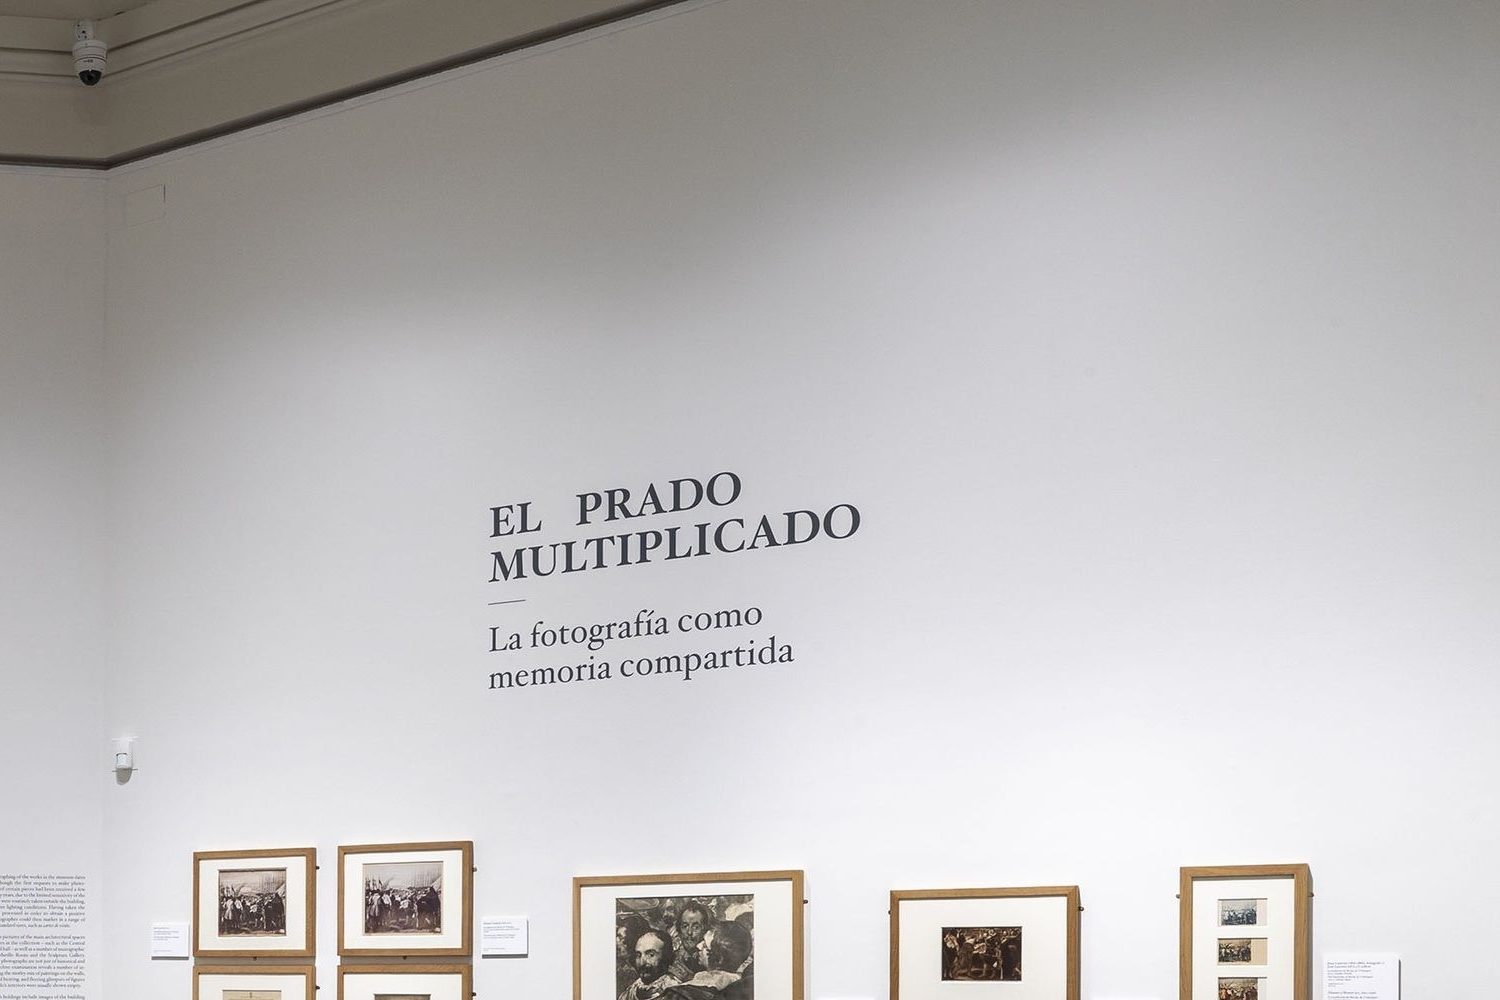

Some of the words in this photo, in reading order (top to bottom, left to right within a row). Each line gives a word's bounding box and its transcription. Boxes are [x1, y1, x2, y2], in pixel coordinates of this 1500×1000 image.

[489, 501, 543, 538] EL
[575, 471, 742, 526] PRADO
[488, 503, 861, 583] MULTIPLICADO
[489, 626, 523, 653] La
[530, 609, 670, 651] fotografía
[677, 607, 763, 633] como
[488, 655, 612, 690] memoria
[620, 636, 795, 681] compartida
